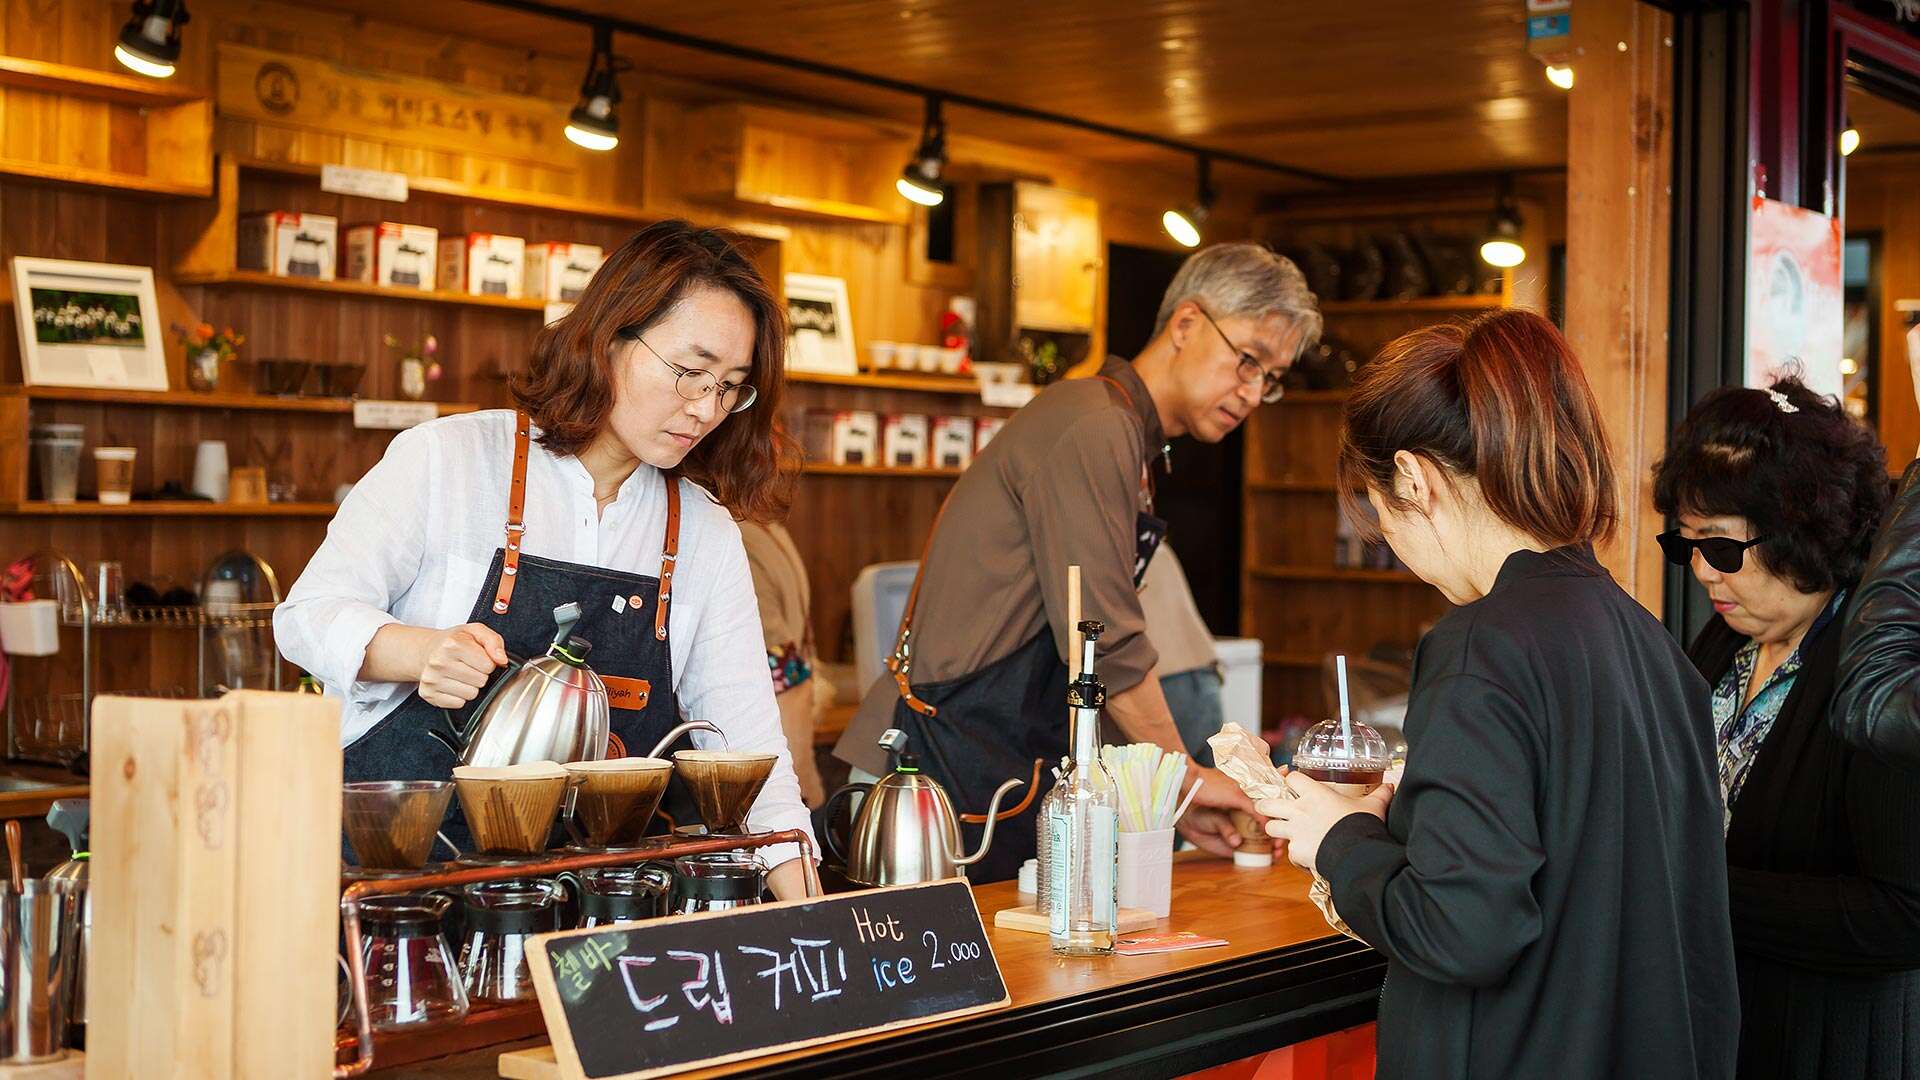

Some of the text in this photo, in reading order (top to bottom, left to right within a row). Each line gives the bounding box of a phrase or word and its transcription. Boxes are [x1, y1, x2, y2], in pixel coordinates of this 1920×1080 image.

[851, 907, 904, 943] Hot
[922, 930, 981, 969] 2.000
[870, 957, 917, 992] ice
